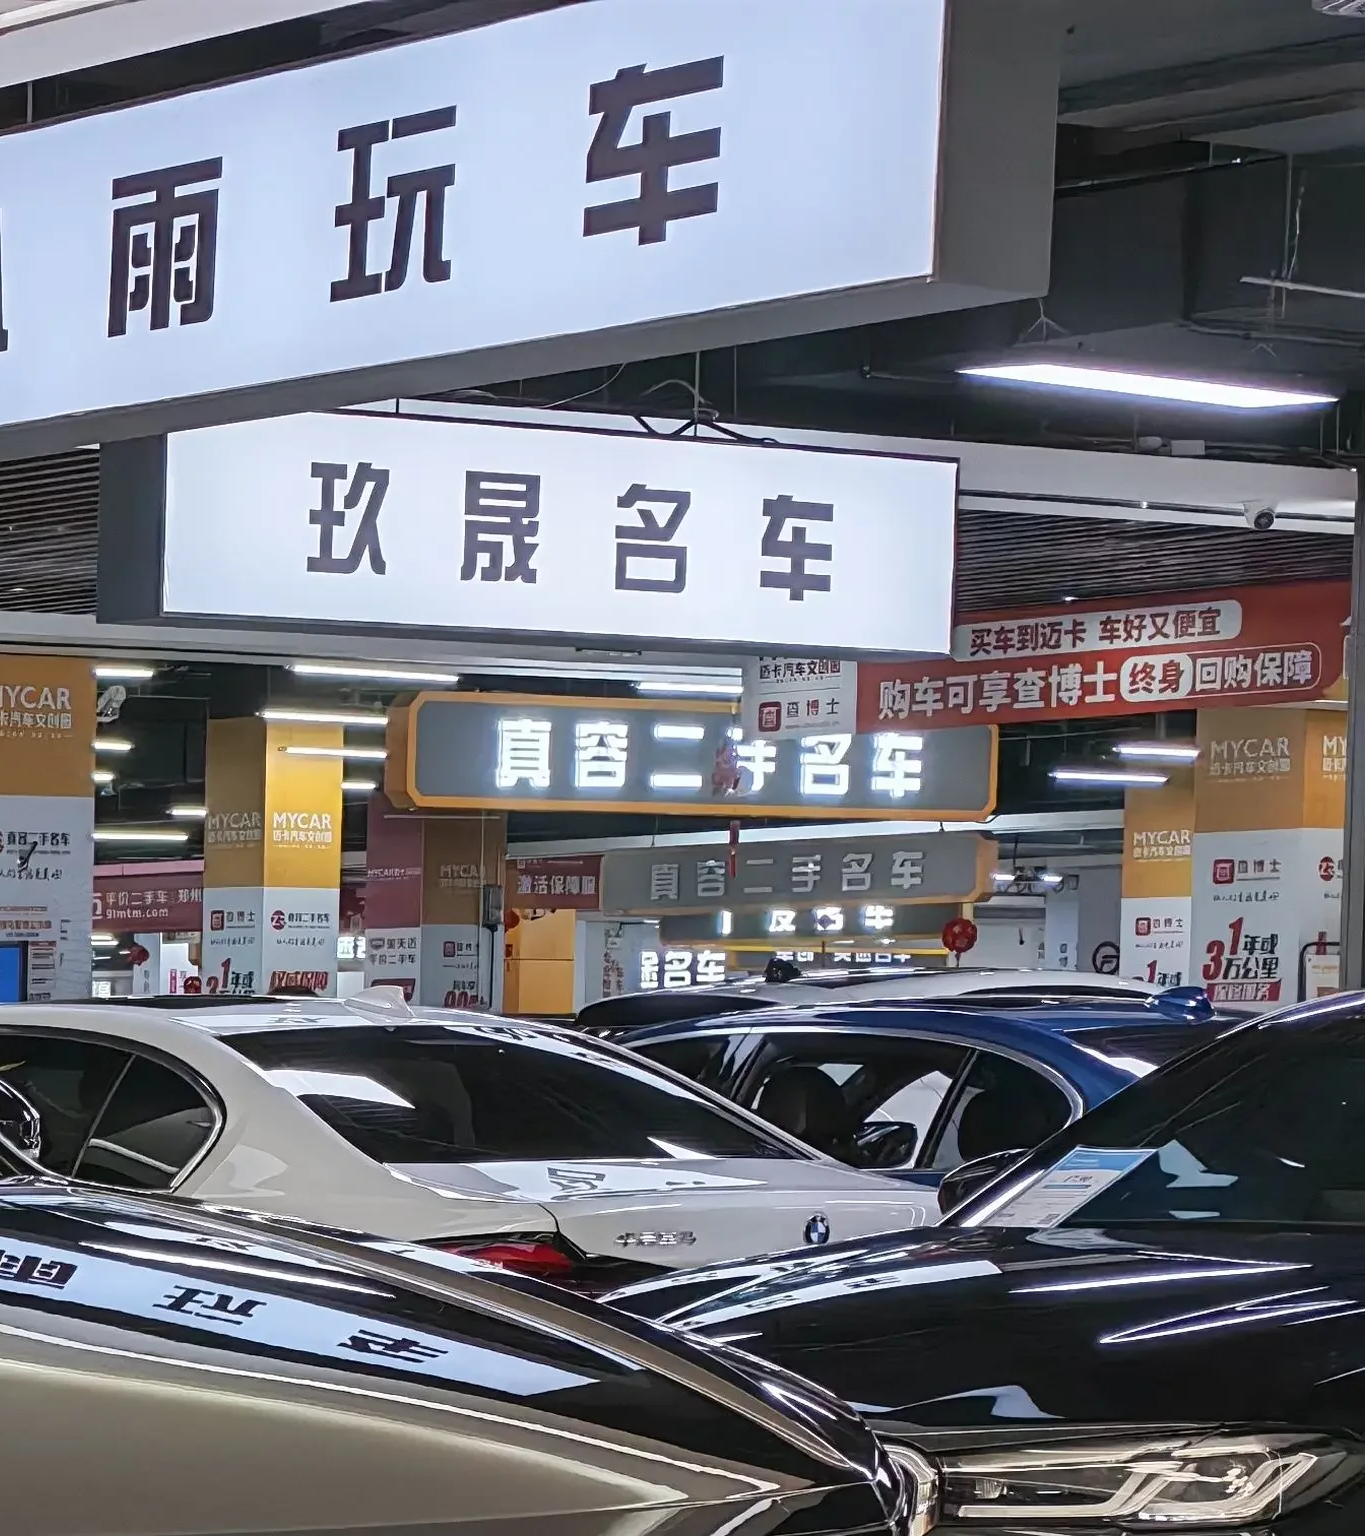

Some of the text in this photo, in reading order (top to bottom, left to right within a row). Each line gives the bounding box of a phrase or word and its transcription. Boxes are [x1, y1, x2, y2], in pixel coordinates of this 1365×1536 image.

[306, 461, 835, 601] 玖晟名车
[970, 606, 1221, 656] 买车到迈卡 车好又便宜
[496, 718, 924, 798] 真容二手名车
[1210, 736, 1290, 760] MYCAR
[208, 812, 262, 829] MYCAR
[273, 812, 332, 829] MYCAR
[1133, 829, 1191, 846] MYCAR
[650, 851, 924, 900] 真容二手名车
[106, 890, 169, 906] 平价二手车
